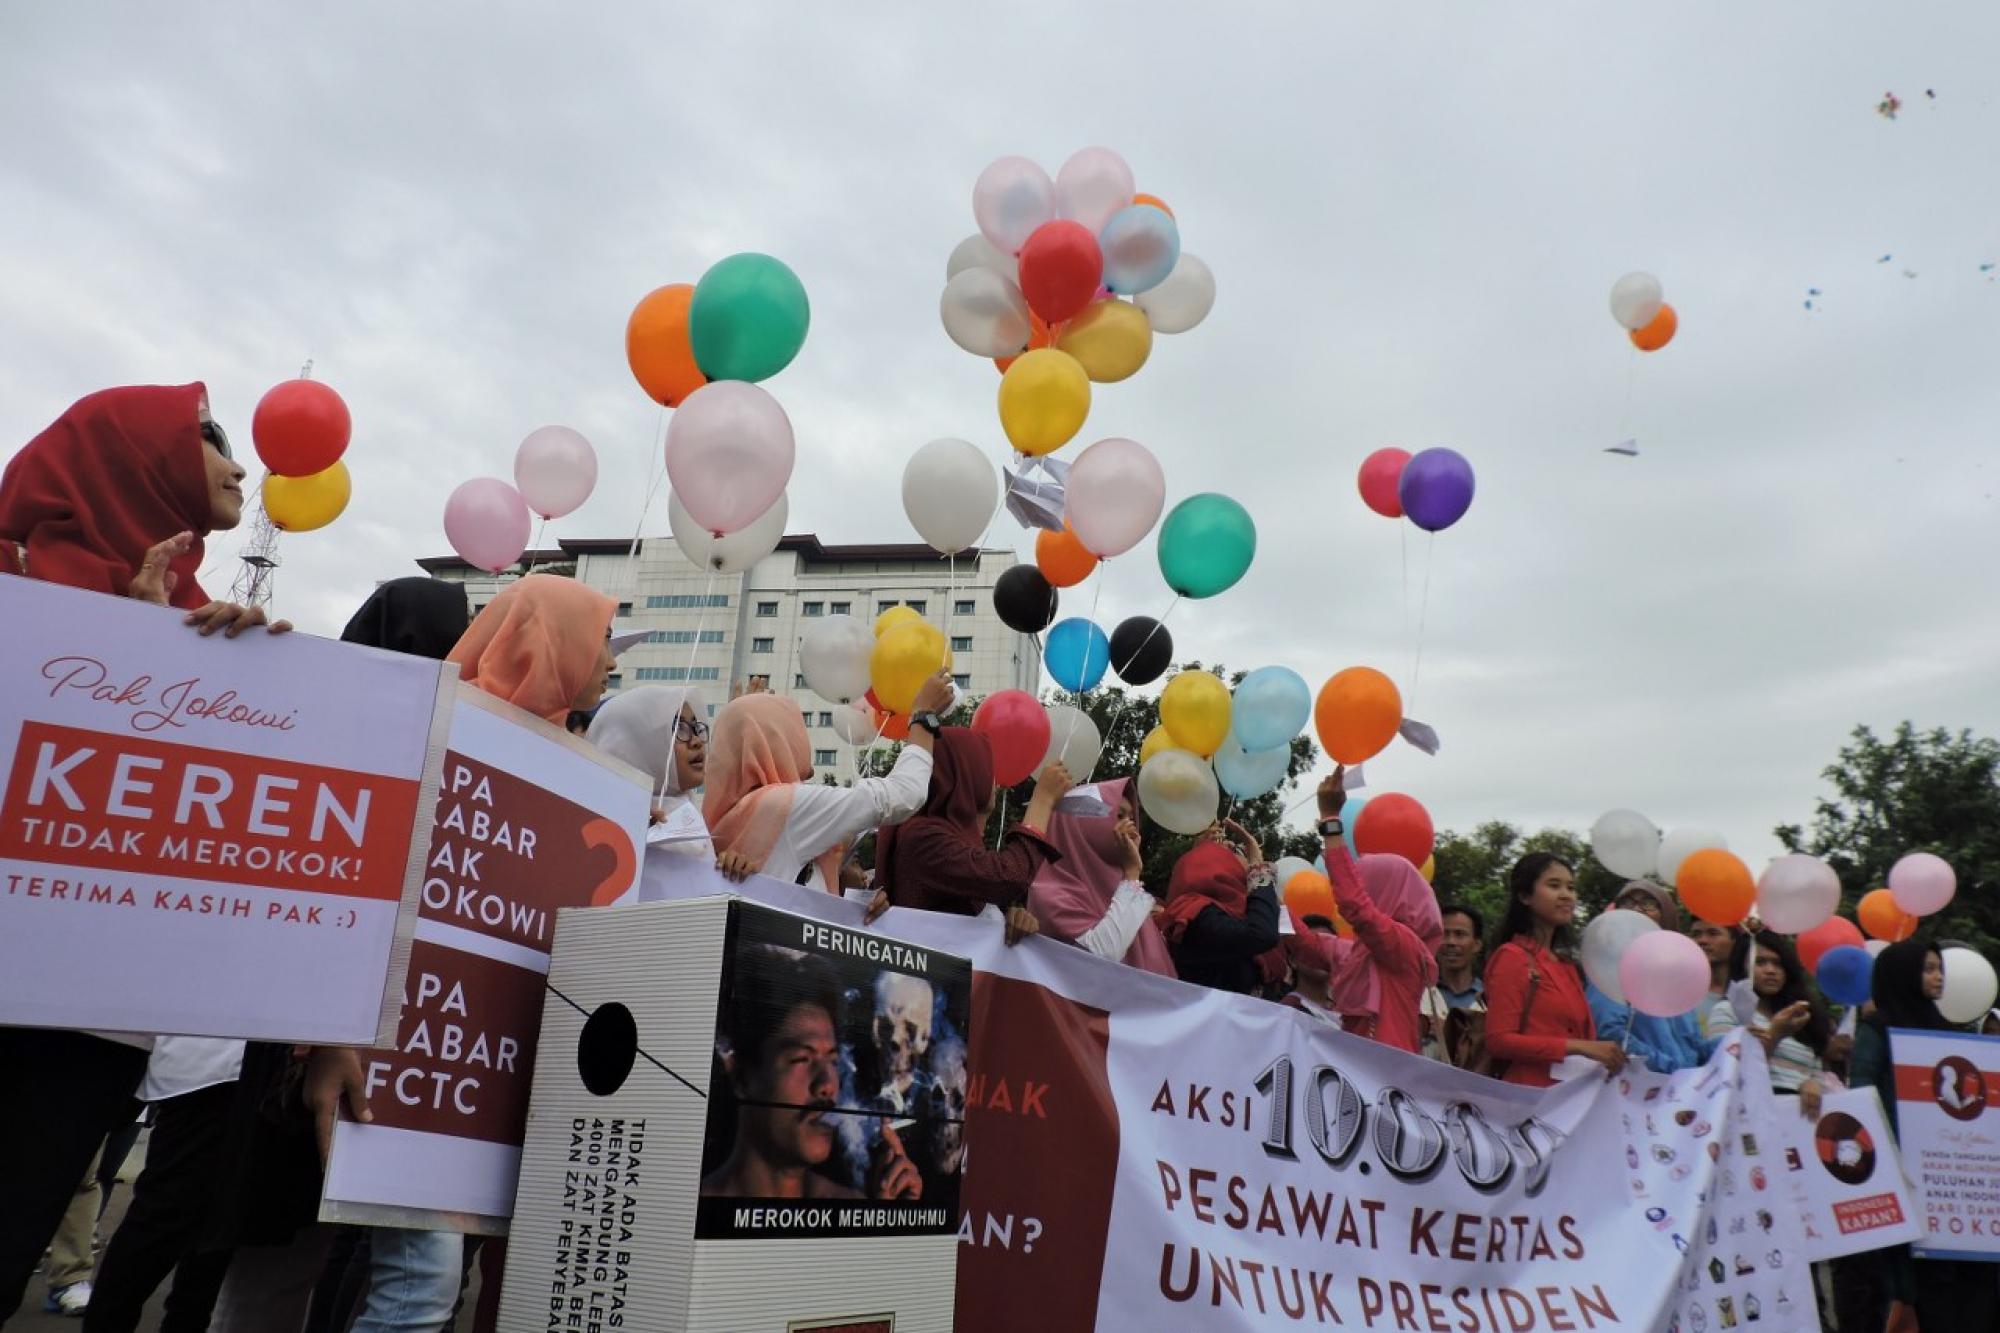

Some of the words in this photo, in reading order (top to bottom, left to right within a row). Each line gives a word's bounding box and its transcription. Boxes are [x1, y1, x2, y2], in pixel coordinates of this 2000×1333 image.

[41, 655, 152, 706] Pak
[130, 678, 300, 732] Jokowi
[26, 741, 372, 848] KEREN
[441, 764, 493, 807] PA
[22, 818, 146, 857] TIDAK
[158, 836, 363, 881] MEROKOK!
[434, 797, 537, 860] ABAR
[430, 841, 485, 882] AK
[7, 874, 136, 907] TERIMA
[153, 890, 252, 919] KASIH
[266, 902, 323, 925] PAK
[423, 877, 547, 940] OKOWI
[802, 922, 928, 973] PERINGATAN
[402, 972, 468, 1018] PA
[395, 1016, 519, 1073] ABAR
[365, 1060, 481, 1115] FCTC
[1151, 1079, 1252, 1132] AKSI
[568, 1118, 585, 1162] DAN
[586, 1117, 604, 1166] 4000
[625, 1118, 647, 1187] TIDAK
[563, 1170, 579, 1211] ZAT
[582, 1174, 598, 1216] ZAT
[592, 1119, 625, 1283] MENGANDUNG
[1155, 1159, 1386, 1250] PESAWAT
[1409, 1206, 1586, 1263] KERTAS
[618, 1194, 637, 1242] ADA
[734, 1208, 833, 1229] MEROKOK
[838, 1207, 947, 1229] MEMBUNUHMU
[957, 1209, 1044, 1254] AN?
[546, 1219, 573, 1333] PENYEBA
[572, 1223, 593, 1288] KIMIA
[566, 1296, 584, 1333] BE
[609, 1251, 631, 1328] BATAS
[1158, 1243, 1344, 1325] UNTUK
[1357, 1276, 1622, 1333] PRESIDEN
